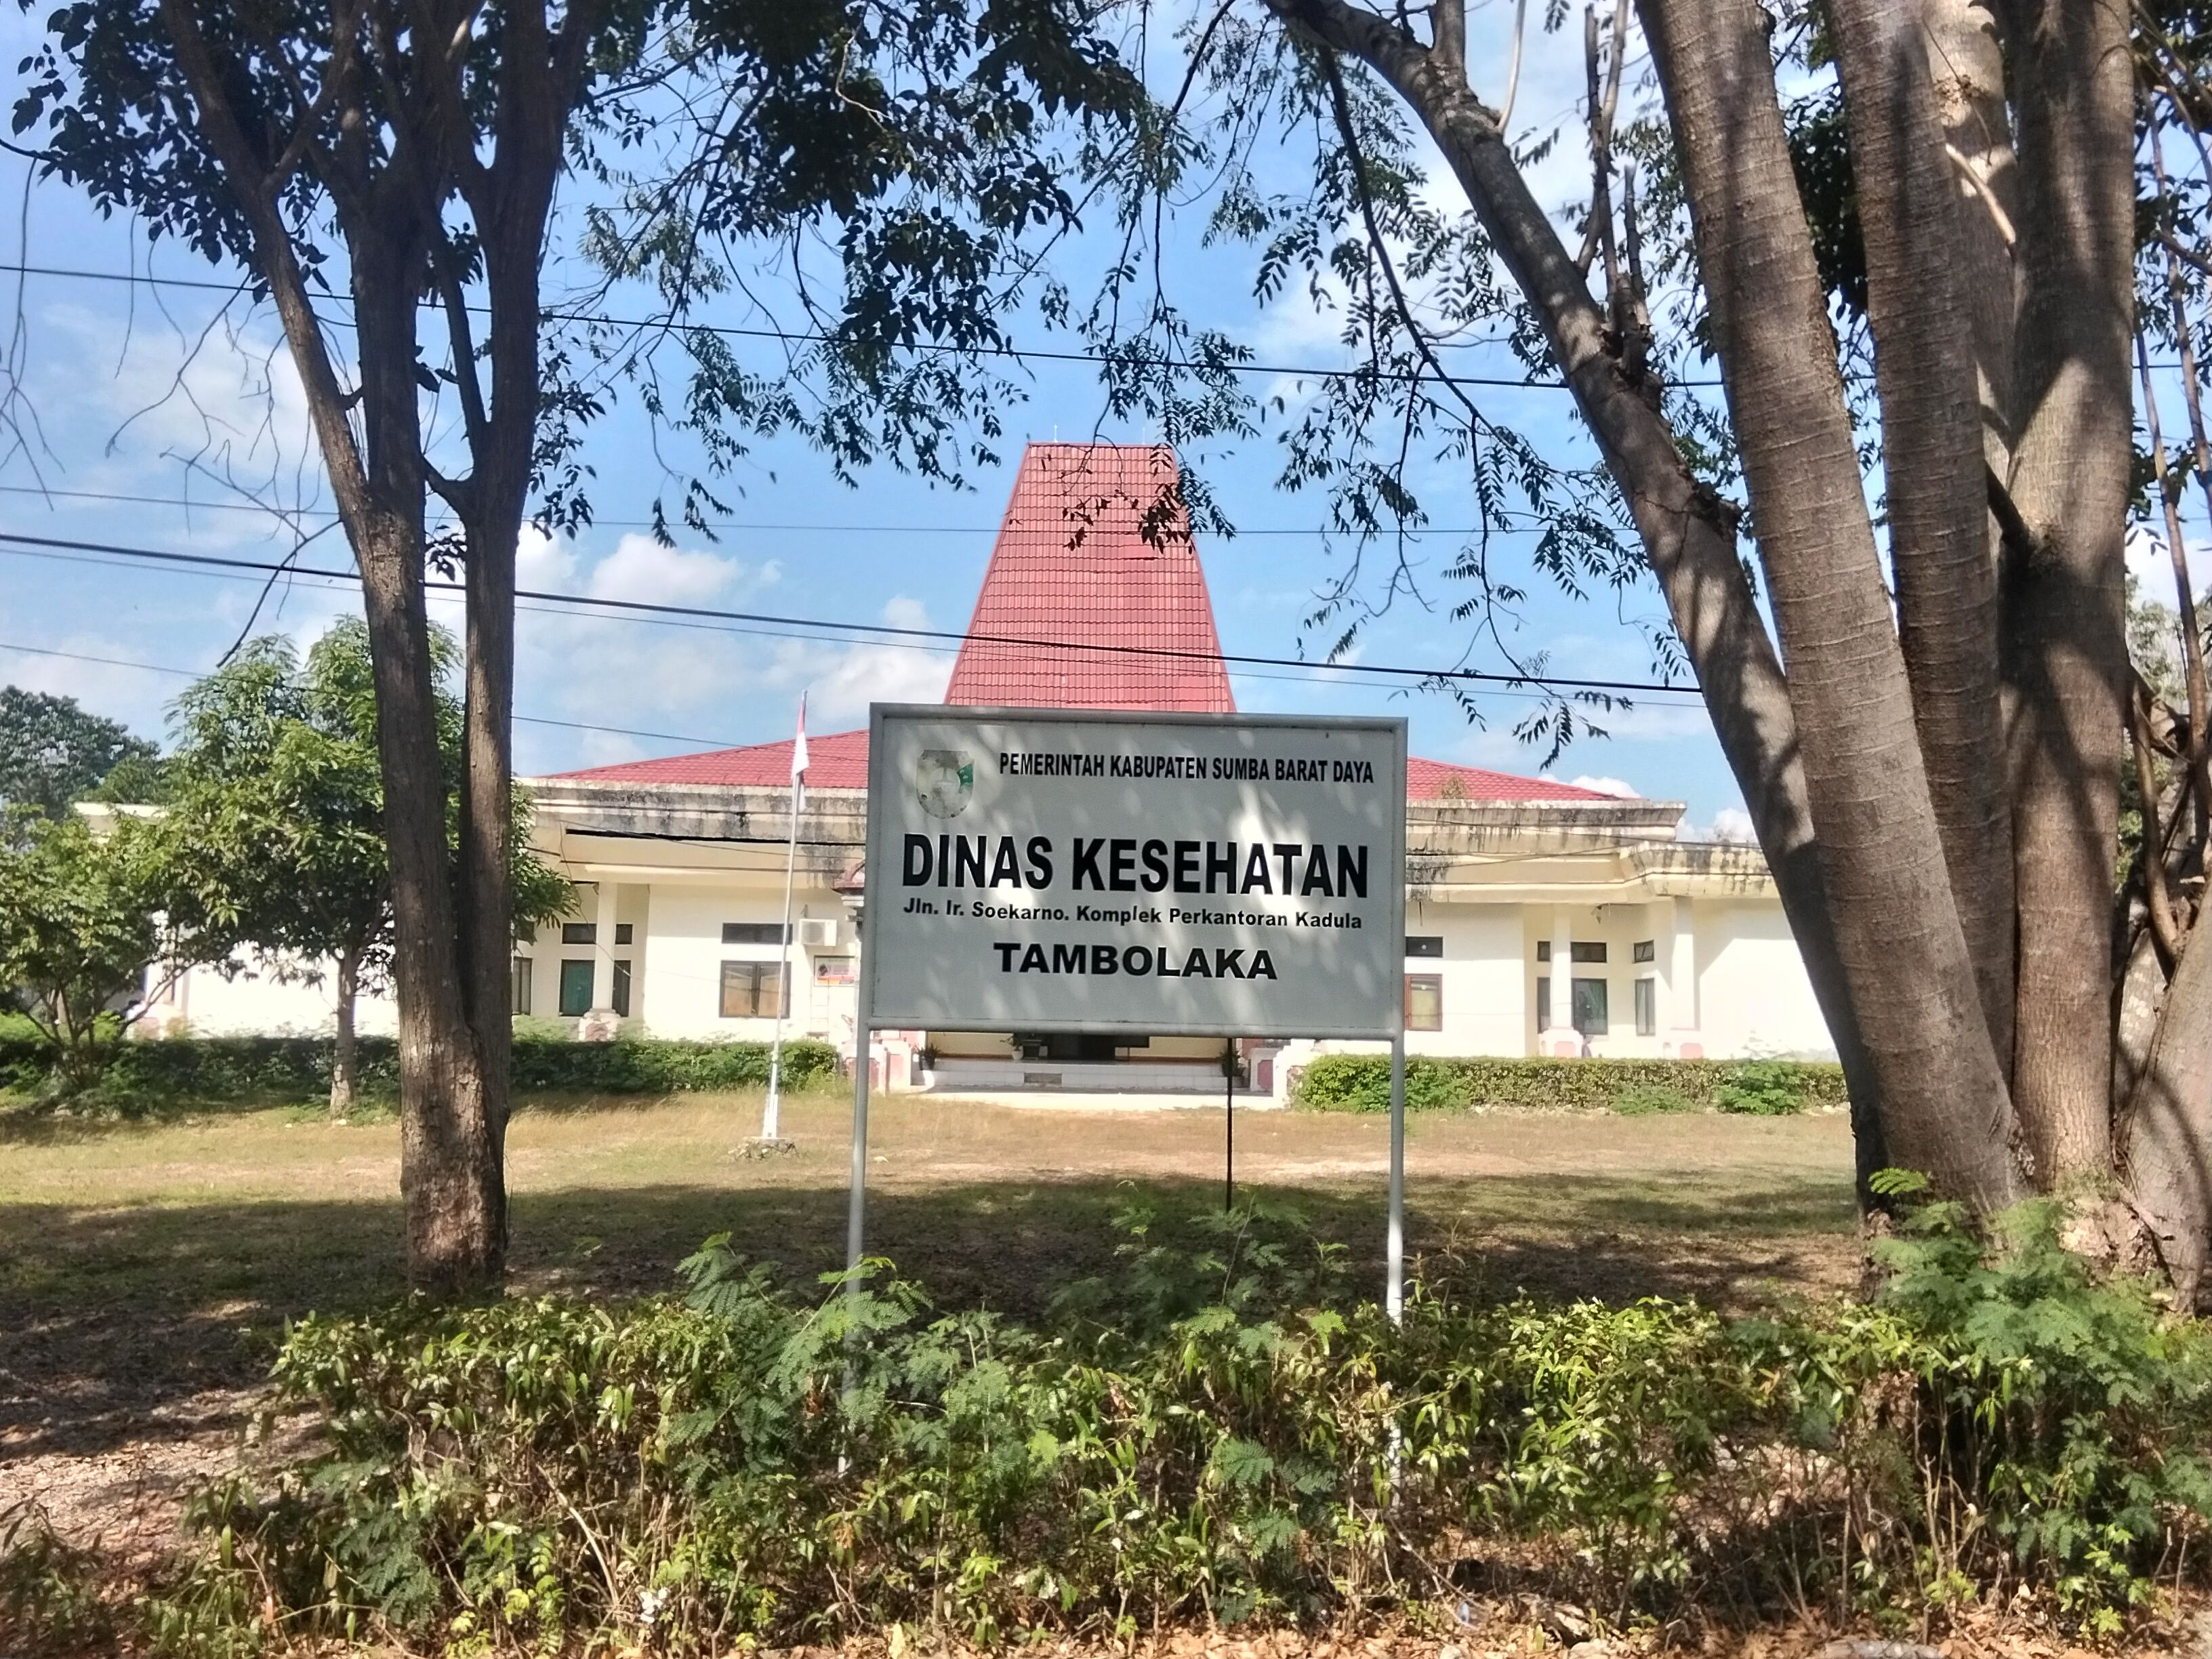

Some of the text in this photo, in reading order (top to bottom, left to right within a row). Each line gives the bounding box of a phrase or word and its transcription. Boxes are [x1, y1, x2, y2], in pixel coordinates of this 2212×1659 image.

[1000, 752, 1374, 784] PEMERINTAH KABUPATEN SUMBA BARAT DAYA
[902, 833, 1369, 899] DINAS KESEHATAN
[903, 897, 1362, 929] Jln. Ir. Soekarno. Komplek Perkantoran Kadula
[993, 942, 1278, 980] TAMBOLAKA
